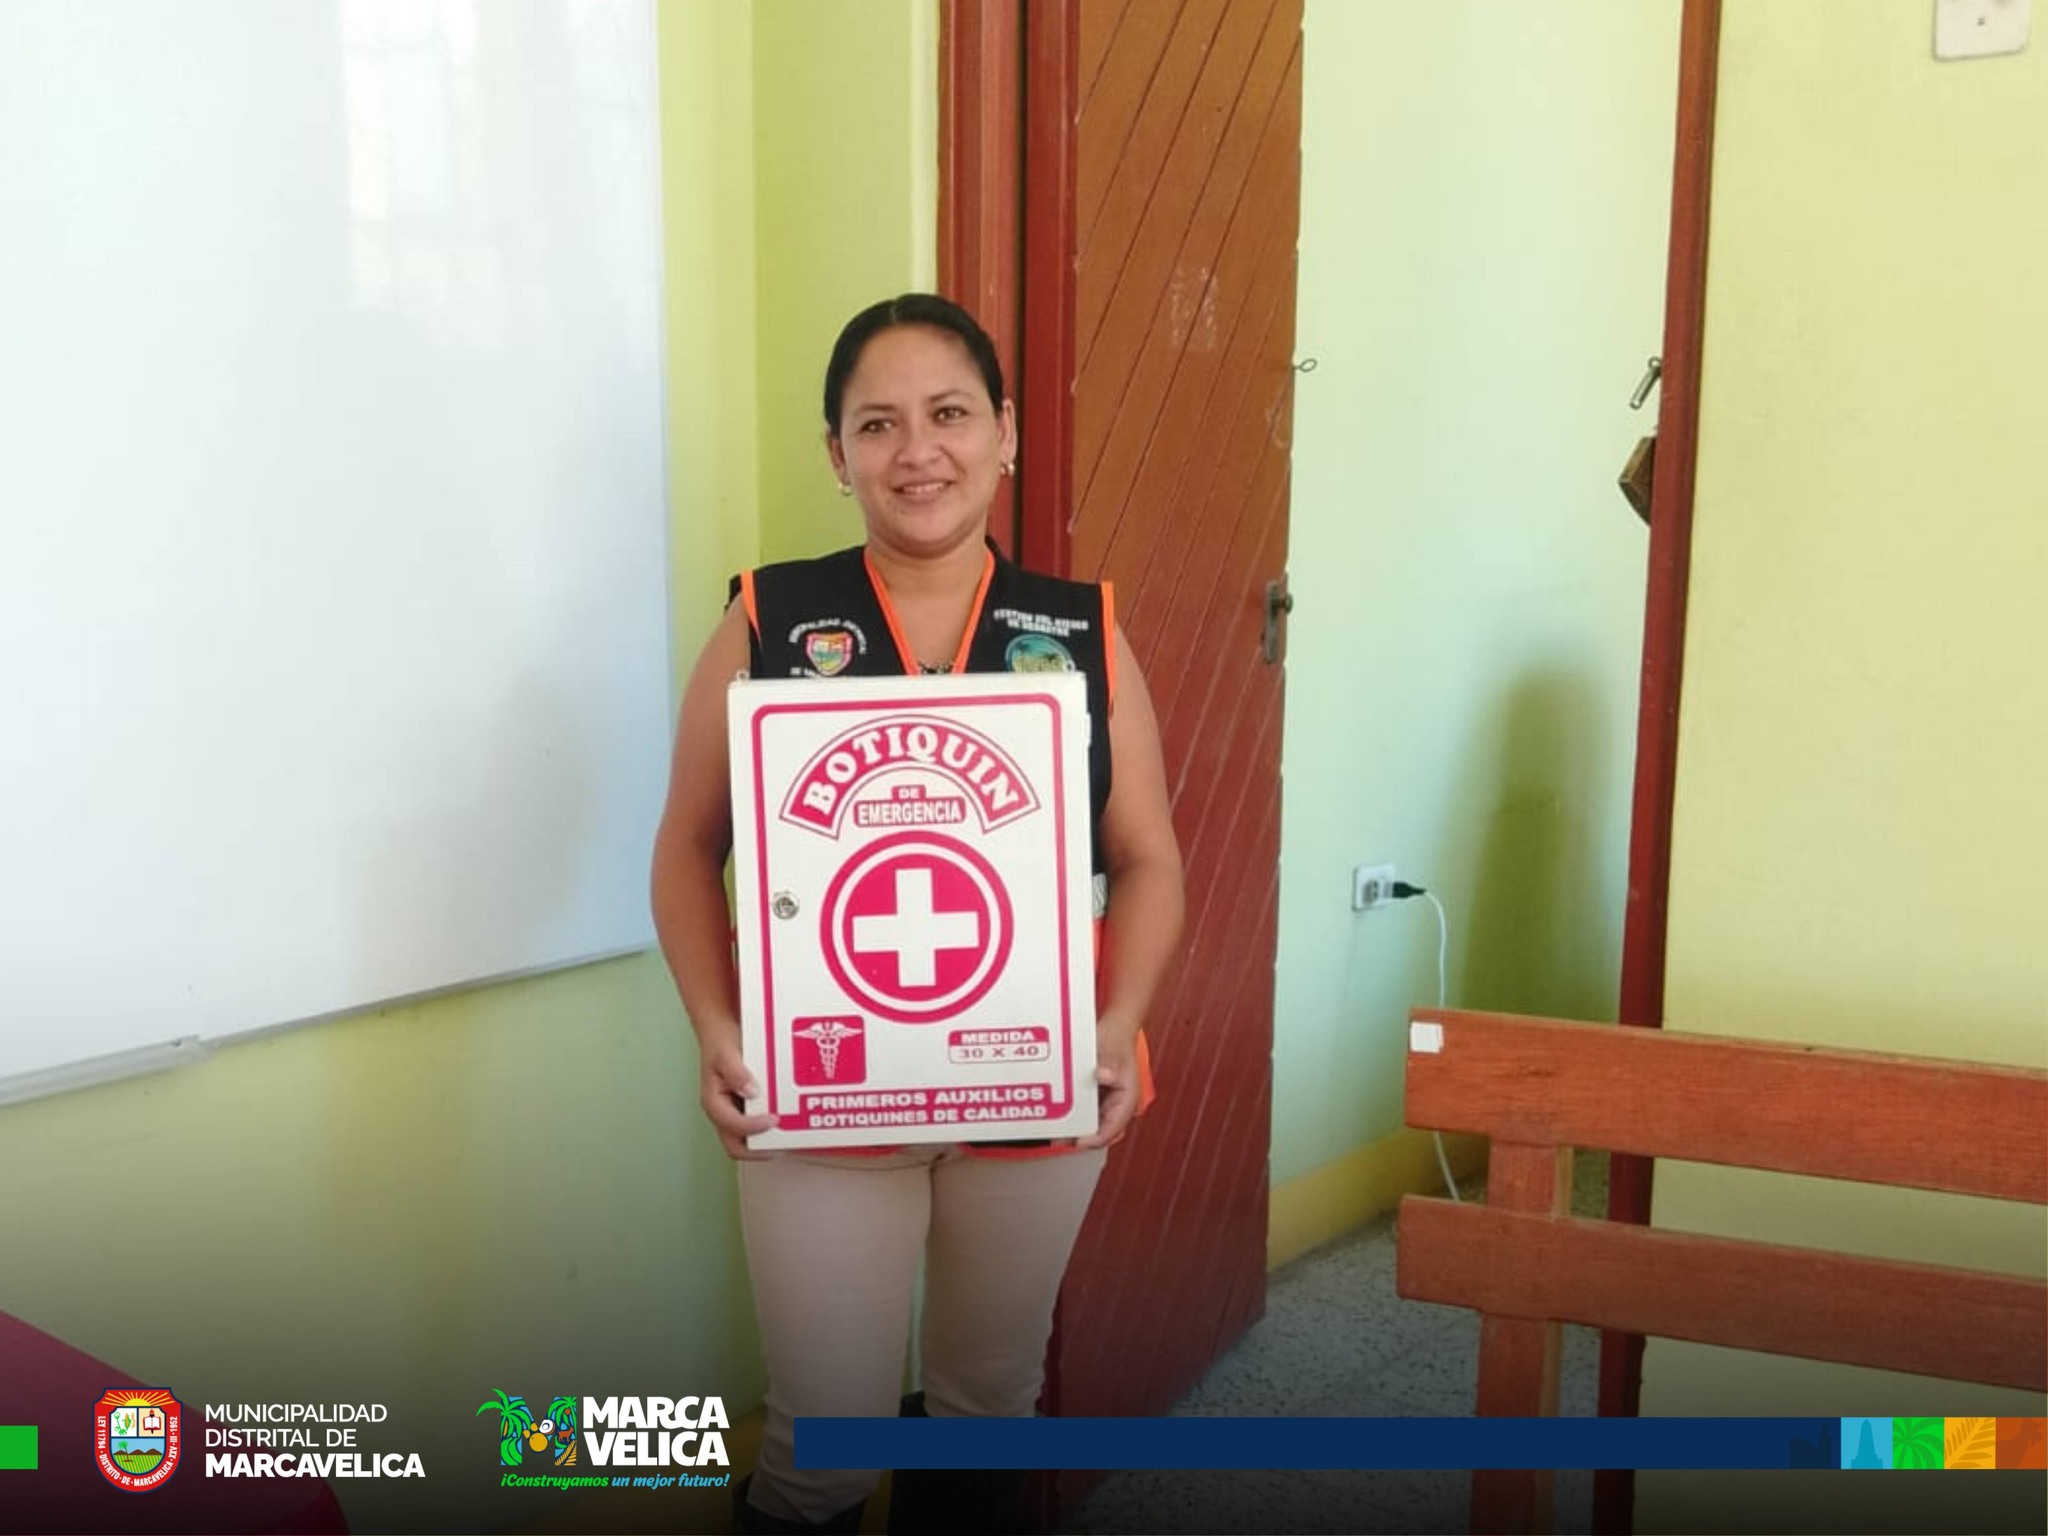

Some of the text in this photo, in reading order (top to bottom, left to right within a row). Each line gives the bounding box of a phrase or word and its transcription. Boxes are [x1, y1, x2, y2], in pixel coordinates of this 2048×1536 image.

[803, 725, 1020, 816] BOTIQUIN
[898, 788, 919, 799] DE
[857, 803, 963, 825] EMERGENCIA
[961, 1030, 1035, 1044] MEDIDA
[958, 1044, 1040, 1060] 30 X 40
[807, 1086, 1045, 1111] PRIMEROS AUXILIOS
[809, 1105, 1048, 1128] BOTIQUINES DE CALIDAD
